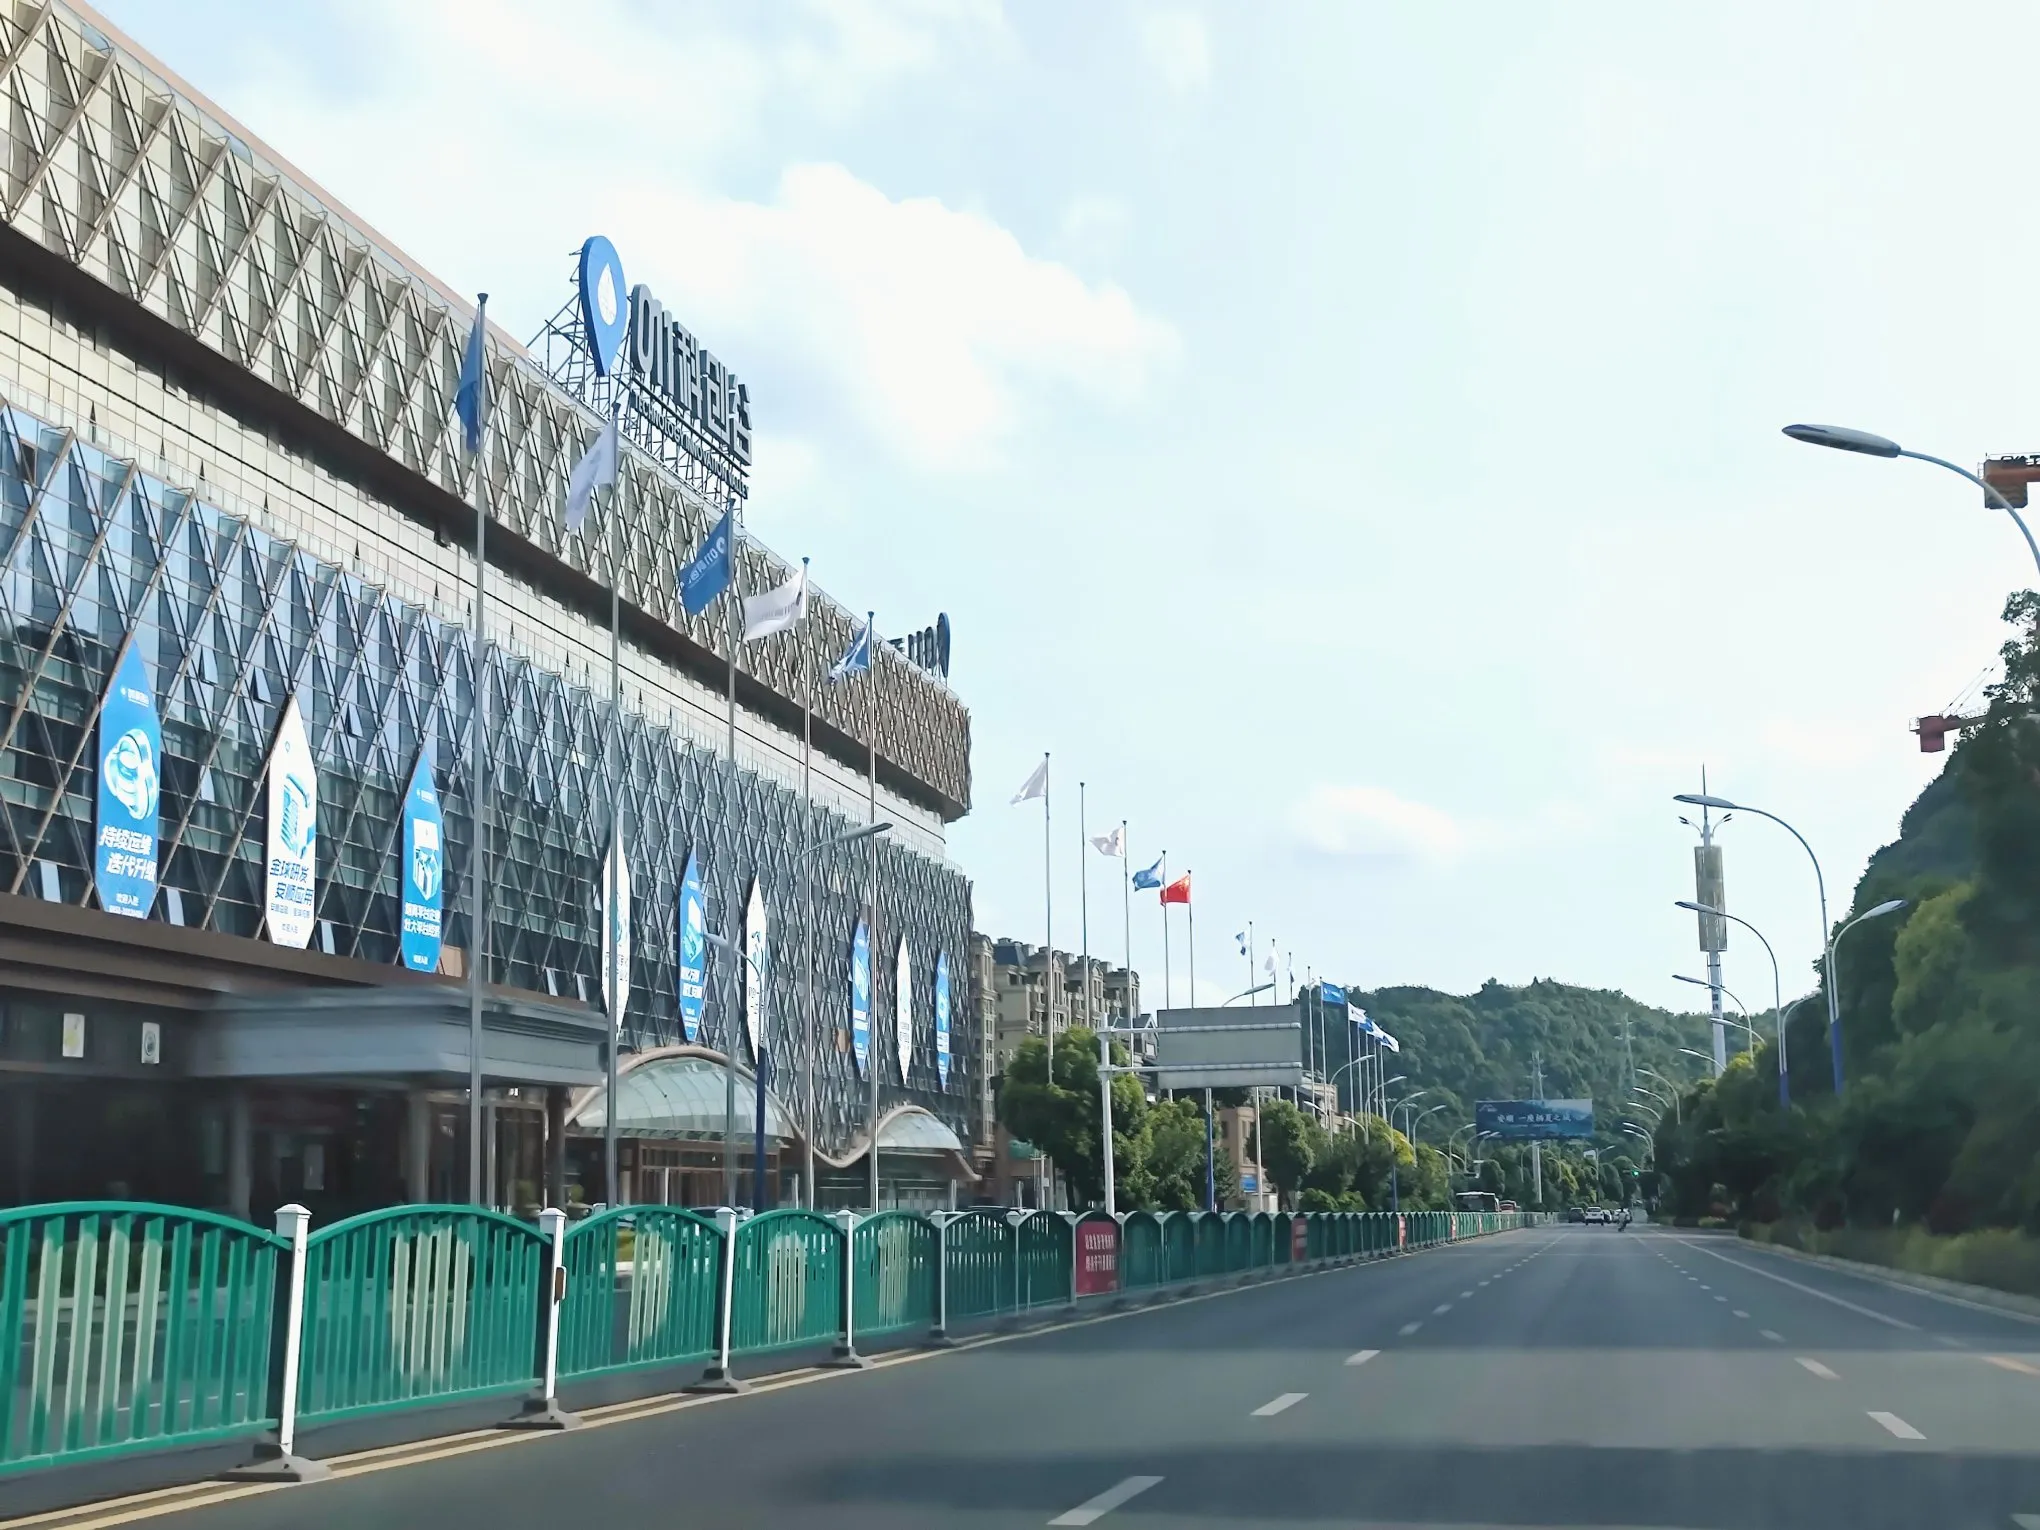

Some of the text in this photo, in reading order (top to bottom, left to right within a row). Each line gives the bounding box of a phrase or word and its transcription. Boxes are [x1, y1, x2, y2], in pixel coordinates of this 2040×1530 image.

[99, 825, 153, 856] 持续运维
[106, 851, 157, 882] 迭代升级
[269, 858, 309, 883] 全球研发
[274, 881, 314, 906] 安顺应用
